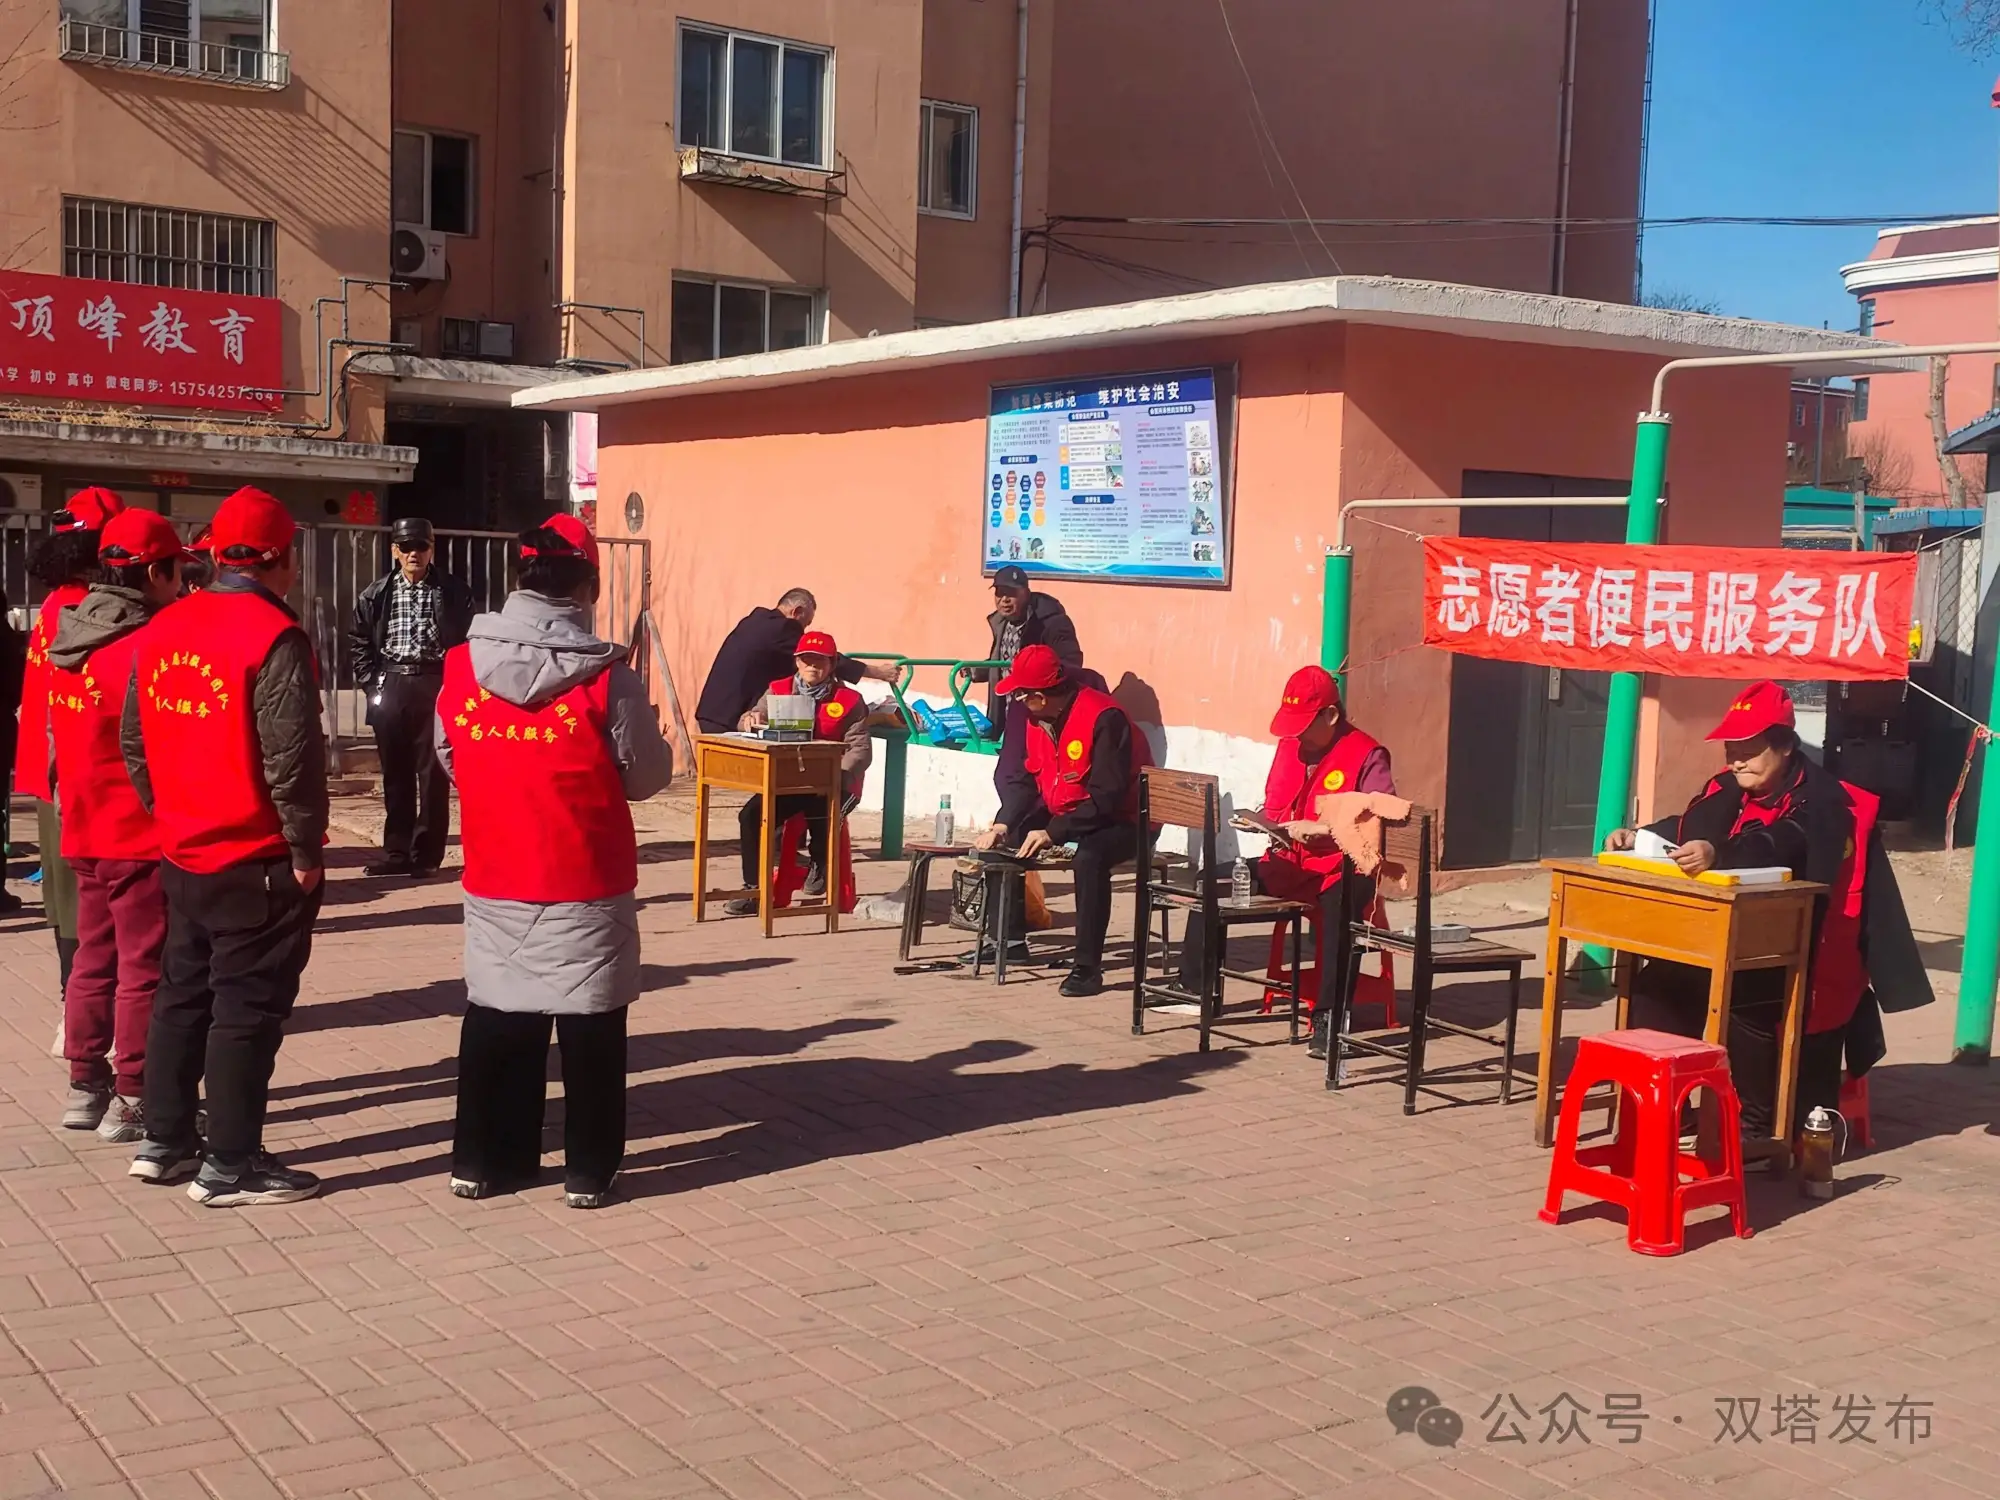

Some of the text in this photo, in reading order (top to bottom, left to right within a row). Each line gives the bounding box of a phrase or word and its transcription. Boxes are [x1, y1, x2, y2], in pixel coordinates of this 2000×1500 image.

[10, 294, 254, 365] 顶峰教育
[30, 369, 56, 384] 初中
[67, 372, 94, 387] 高中
[1098, 381, 1180, 406] 维护社会治安
[1437, 555, 1887, 659] 志愿者便民服务队
[470, 723, 559, 744] 为人民服务
